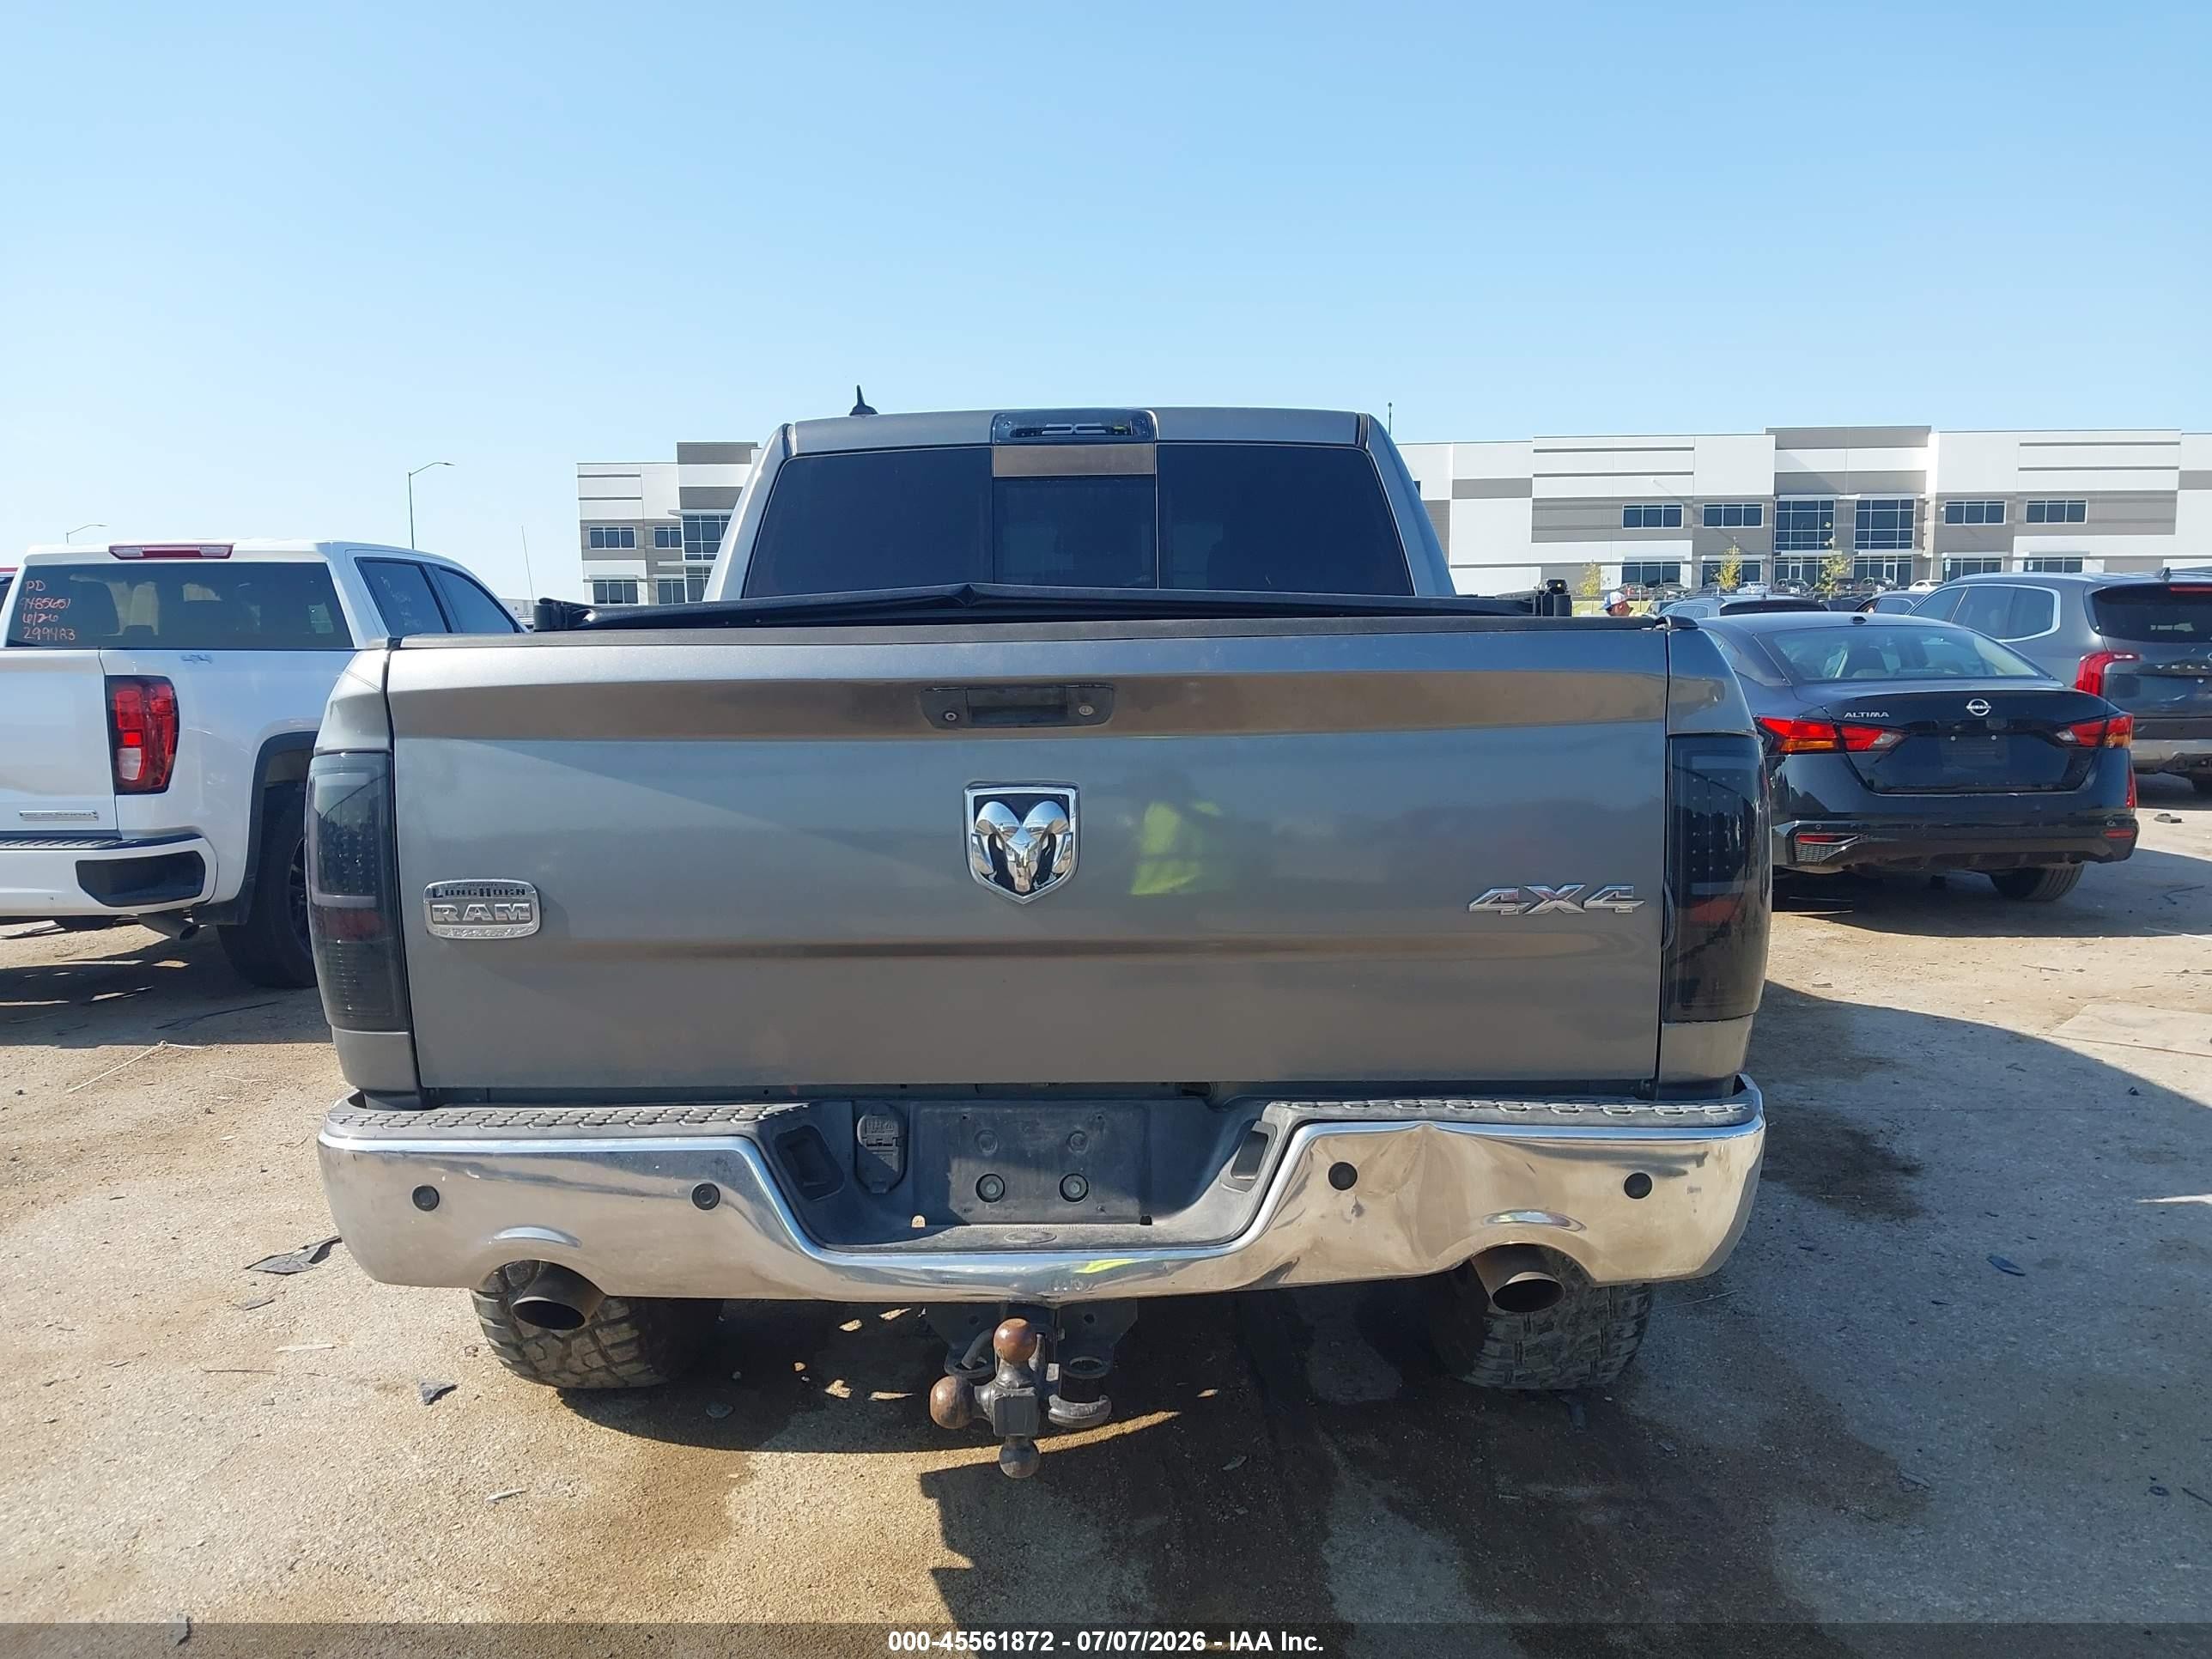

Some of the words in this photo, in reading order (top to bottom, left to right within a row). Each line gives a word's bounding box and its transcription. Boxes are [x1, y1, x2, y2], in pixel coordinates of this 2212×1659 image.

[26, 580, 46, 593] PD
[1468, 884, 1646, 915] 4X4
[431, 903, 532, 921] RAM
